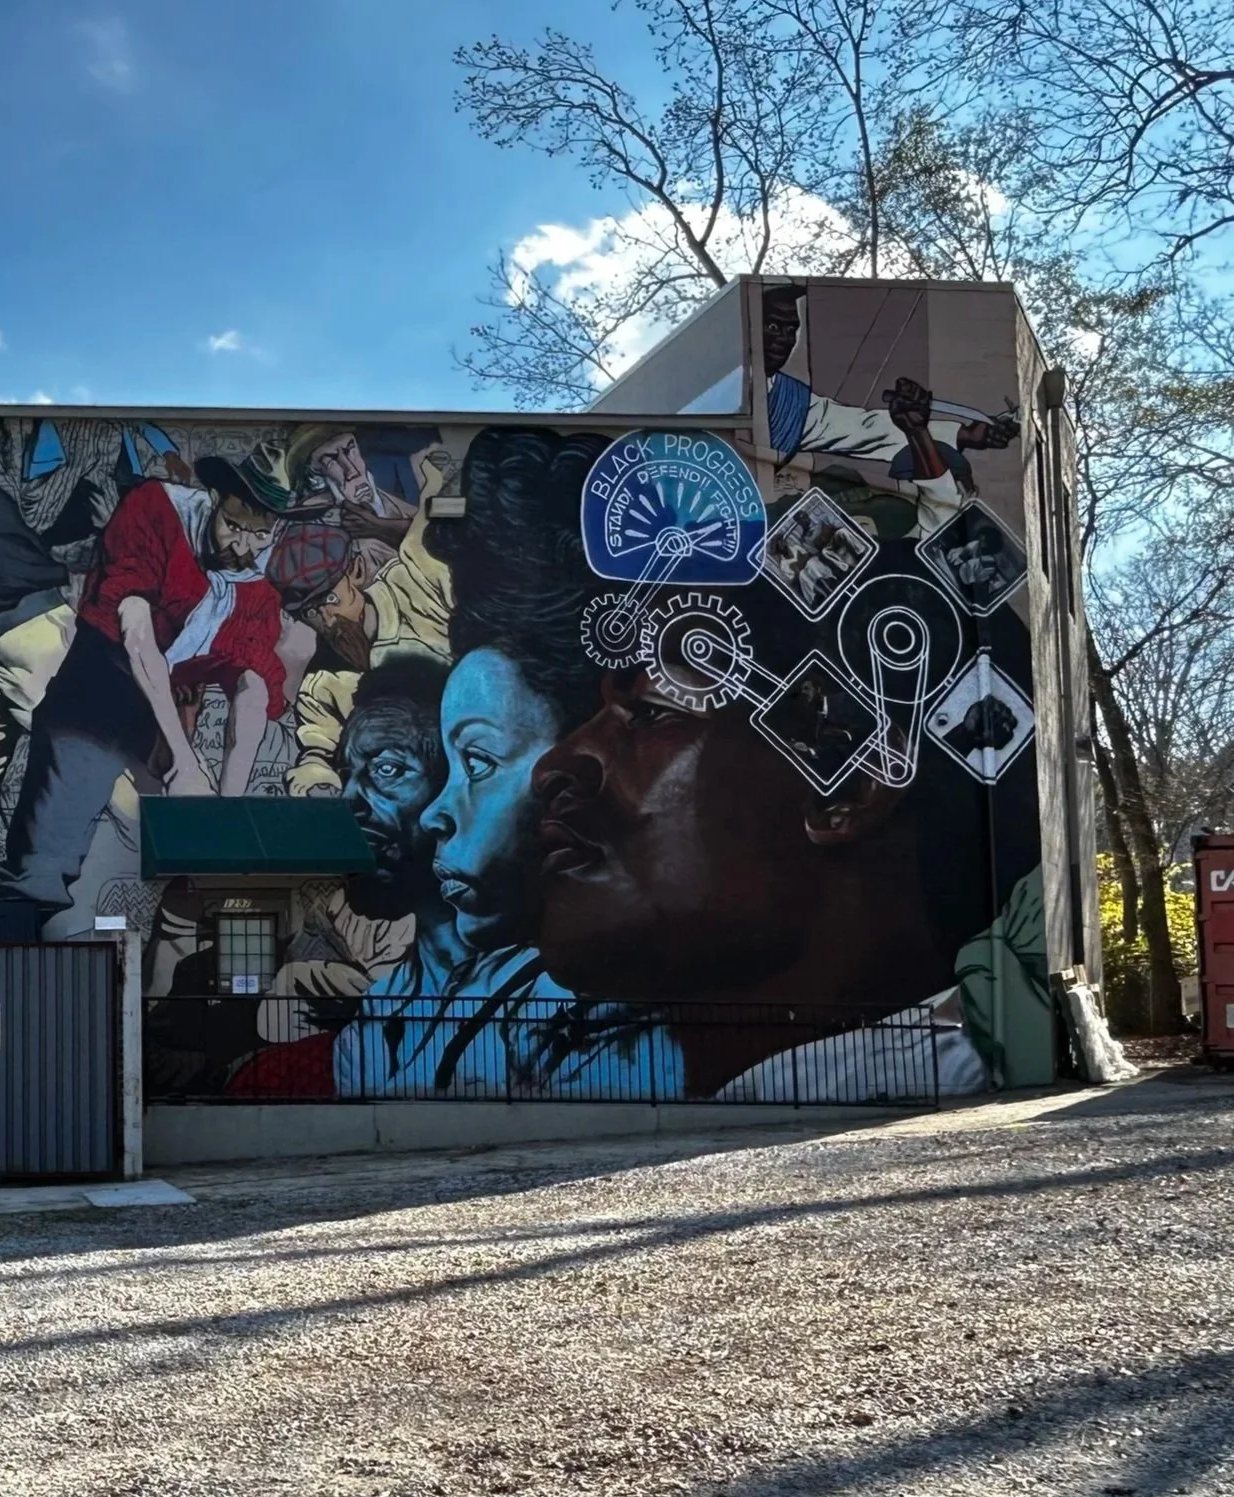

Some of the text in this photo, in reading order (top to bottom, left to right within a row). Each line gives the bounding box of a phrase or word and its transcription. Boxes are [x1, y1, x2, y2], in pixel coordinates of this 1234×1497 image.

[591, 434, 759, 518] BLACK PROGRESS
[609, 465, 737, 554] STAND! DEFEND!! FIGHT!!!
